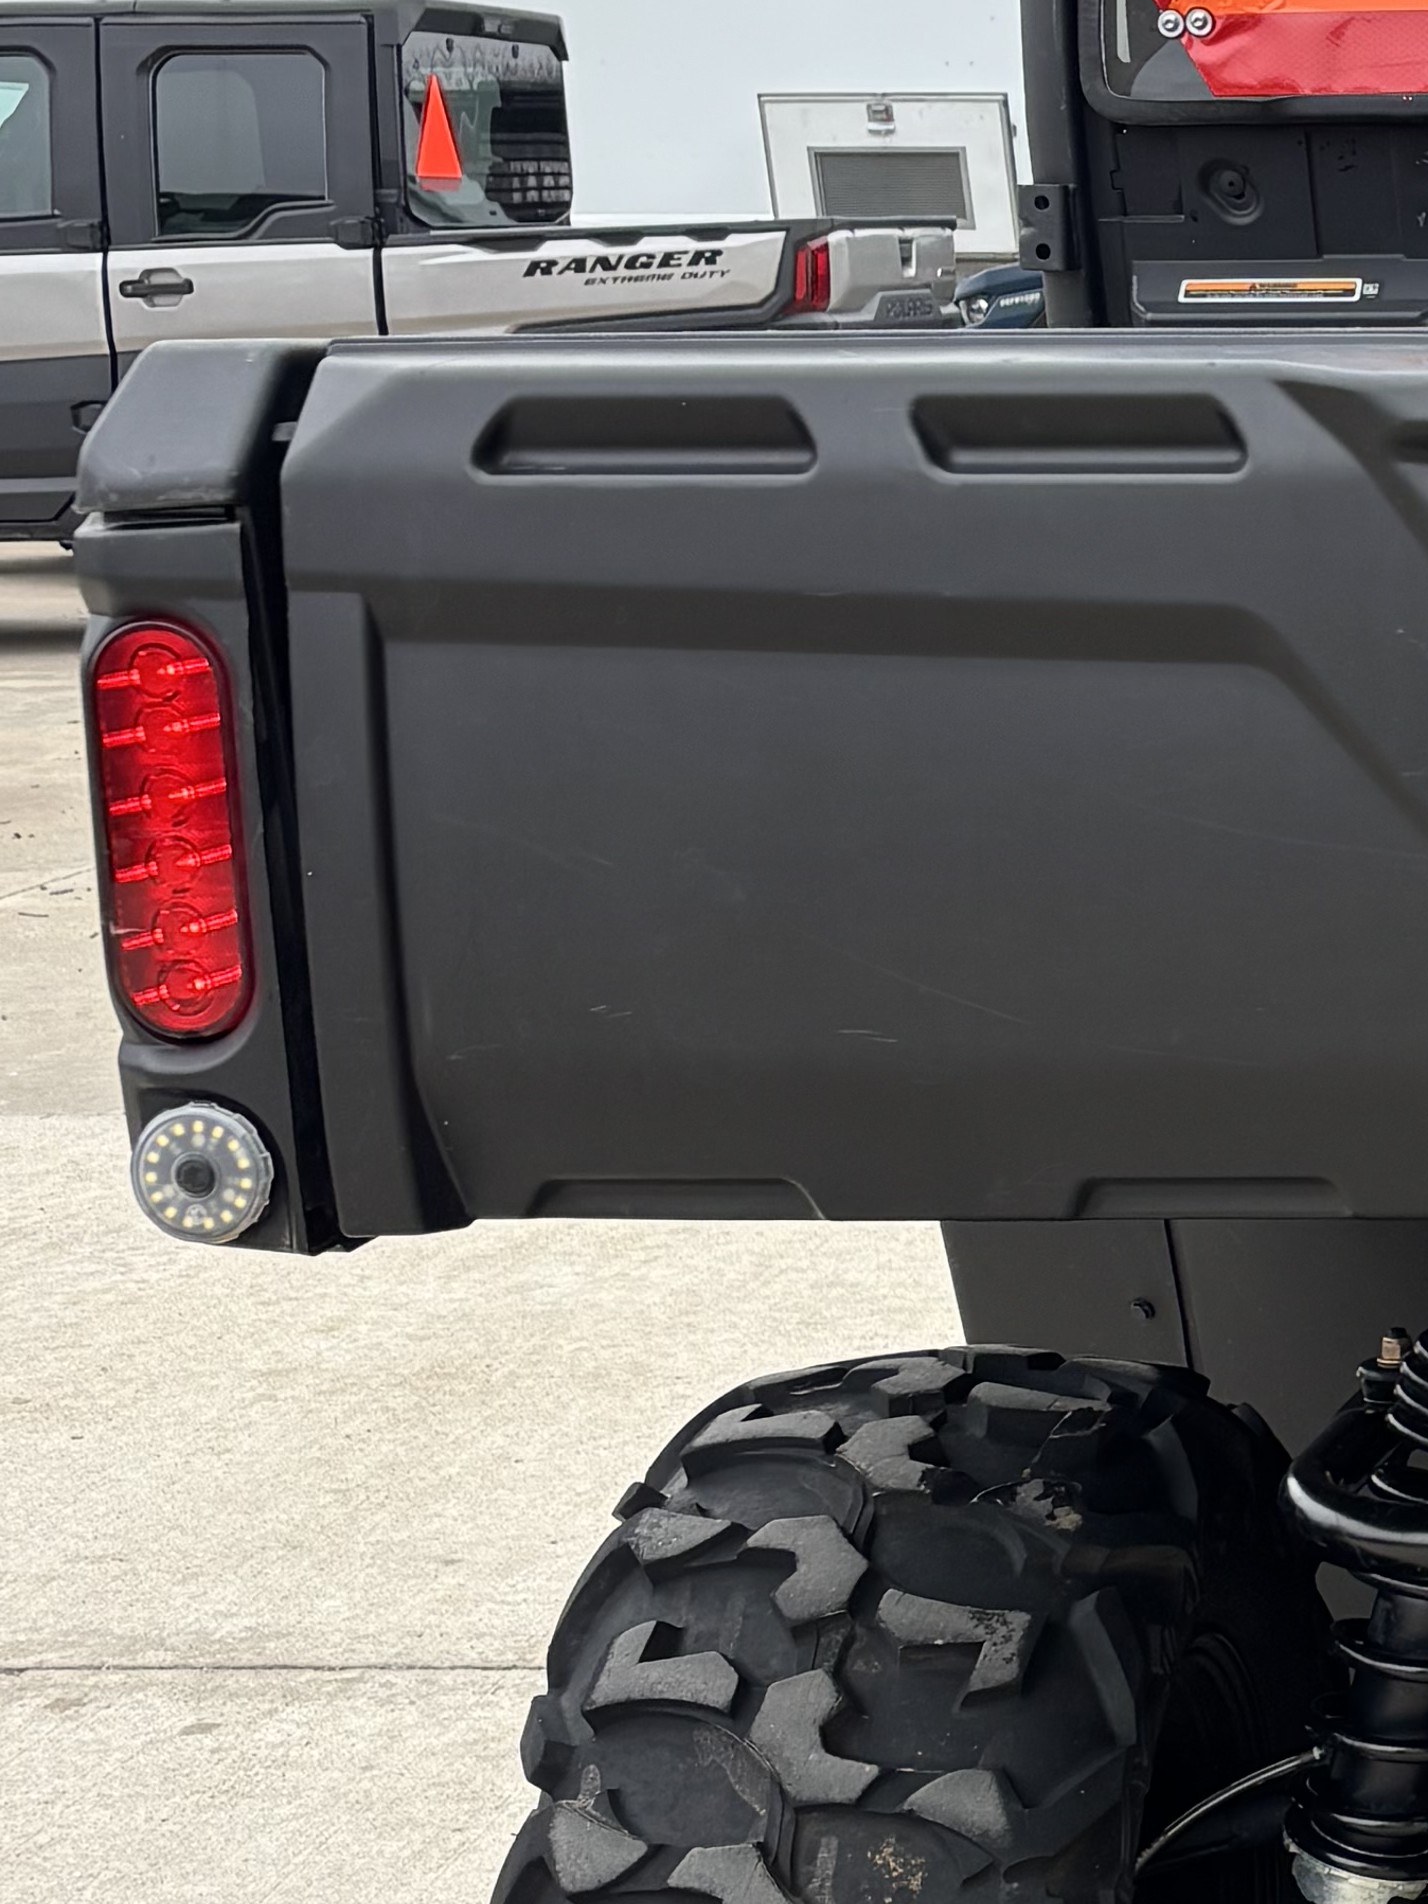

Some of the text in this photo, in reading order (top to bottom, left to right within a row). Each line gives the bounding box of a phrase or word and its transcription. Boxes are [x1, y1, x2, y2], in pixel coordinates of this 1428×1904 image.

[522, 249, 724, 277] RANGER
[583, 269, 731, 286] EXTREME DUTY
